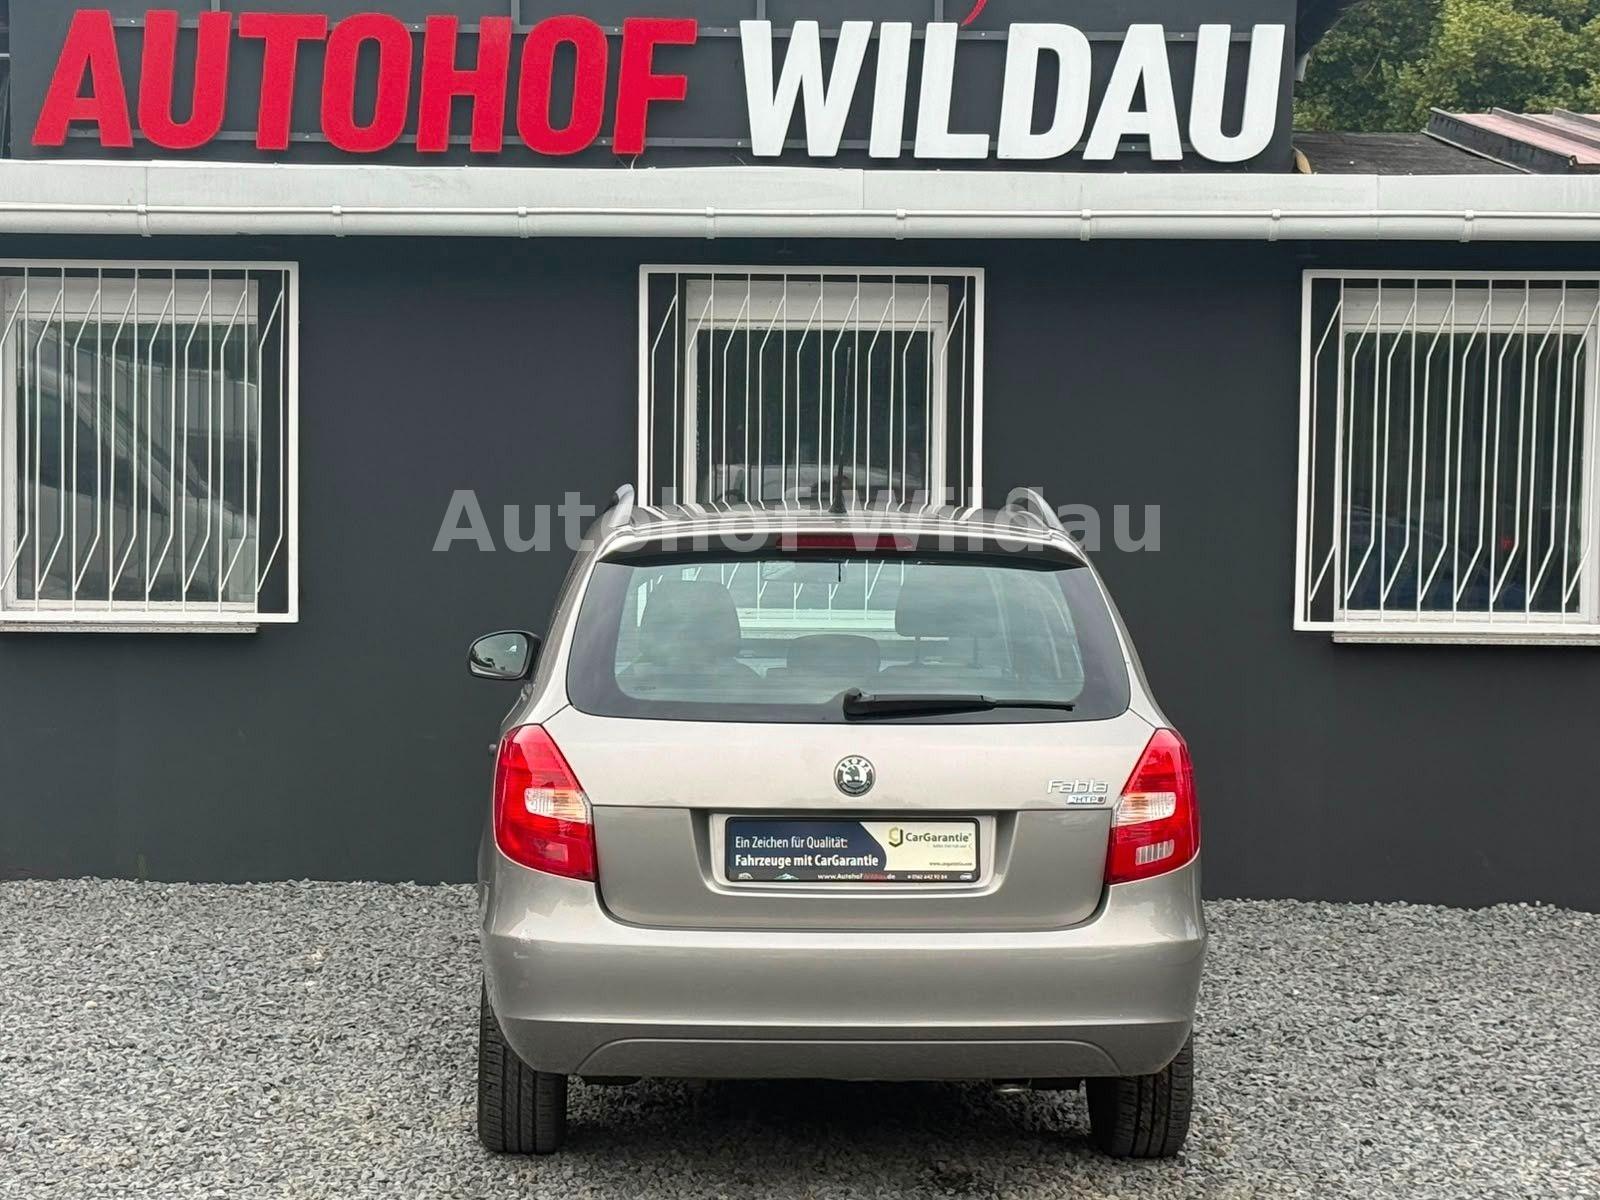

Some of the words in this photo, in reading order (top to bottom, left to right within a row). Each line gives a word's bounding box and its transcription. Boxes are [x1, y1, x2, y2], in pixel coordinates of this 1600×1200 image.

[32, 9, 697, 155] AUTOHOF
[739, 20, 1286, 163] WILDAU
[1047, 779, 1108, 793] Fabia
[735, 836, 750, 849] Ein
[752, 836, 789, 849] Zeichen
[791, 836, 805, 849] für
[806, 836, 848, 849] Qualität:
[735, 854, 792, 868] Fahrzeuge
[794, 855, 813, 867] mit
[814, 854, 879, 867] CarGarantie
